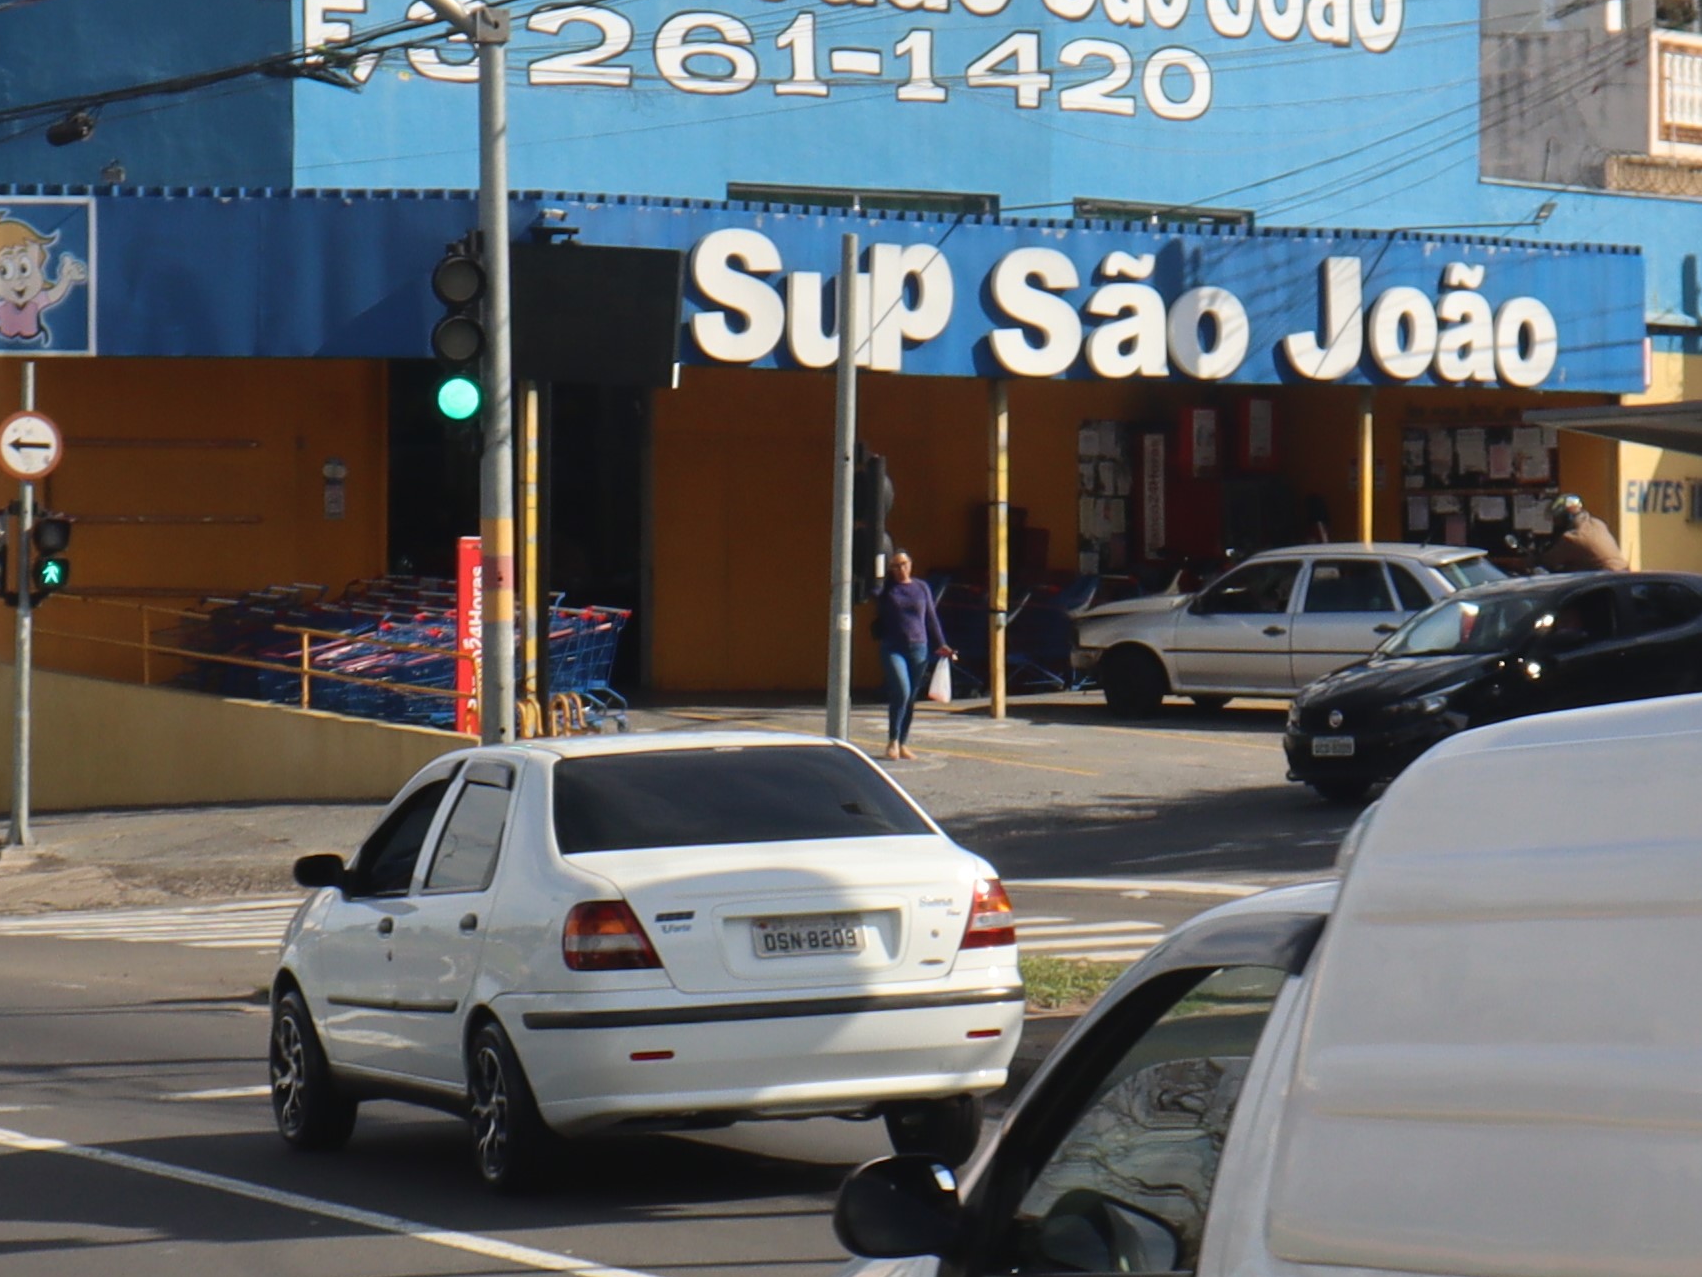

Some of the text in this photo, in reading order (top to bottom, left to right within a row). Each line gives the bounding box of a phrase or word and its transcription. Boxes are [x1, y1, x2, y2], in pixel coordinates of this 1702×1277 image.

[691, 228, 1558, 388] Sup São João
[1626, 480, 1684, 514] ENTES
